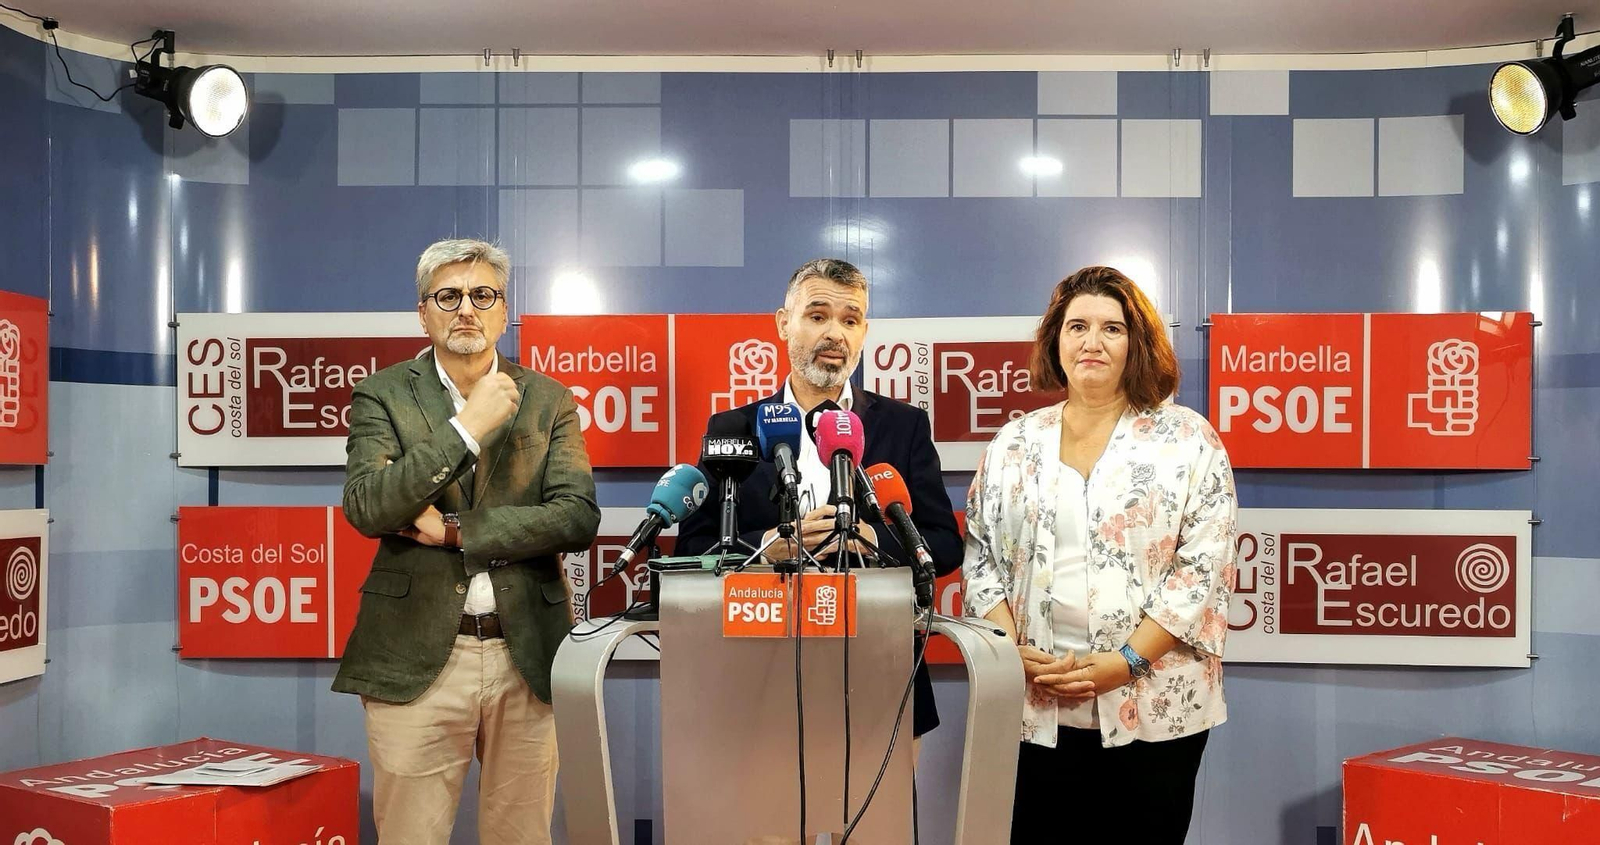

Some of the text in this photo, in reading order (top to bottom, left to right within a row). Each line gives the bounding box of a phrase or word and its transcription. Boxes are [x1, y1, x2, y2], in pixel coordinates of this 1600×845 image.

[253, 346, 377, 389] Rafael
[531, 345, 657, 373] Marbella
[874, 343, 912, 404] ES
[914, 342, 929, 366] sol
[940, 351, 1033, 394] Rafa
[1220, 344, 1352, 373] Marbella
[187, 338, 225, 436] CES
[227, 337, 242, 438] costa del sol
[914, 371, 929, 395] del
[567, 385, 659, 434] SOE
[764, 404, 792, 417] M95
[1218, 386, 1353, 434] PSOE
[181, 543, 325, 564] Costa del Sol
[1287, 542, 1417, 587] Rafael
[570, 562, 585, 588] del
[728, 587, 783, 599] Andalucía
[1261, 532, 1275, 634] costa del sol
[189, 577, 318, 624] PSOE
[728, 602, 783, 623] PSOE
[1317, 584, 1511, 630] Escuredo
[19, 747, 248, 788] Andalucía
[1387, 751, 1600, 788] PSO
[1429, 745, 1600, 772] Andalu
